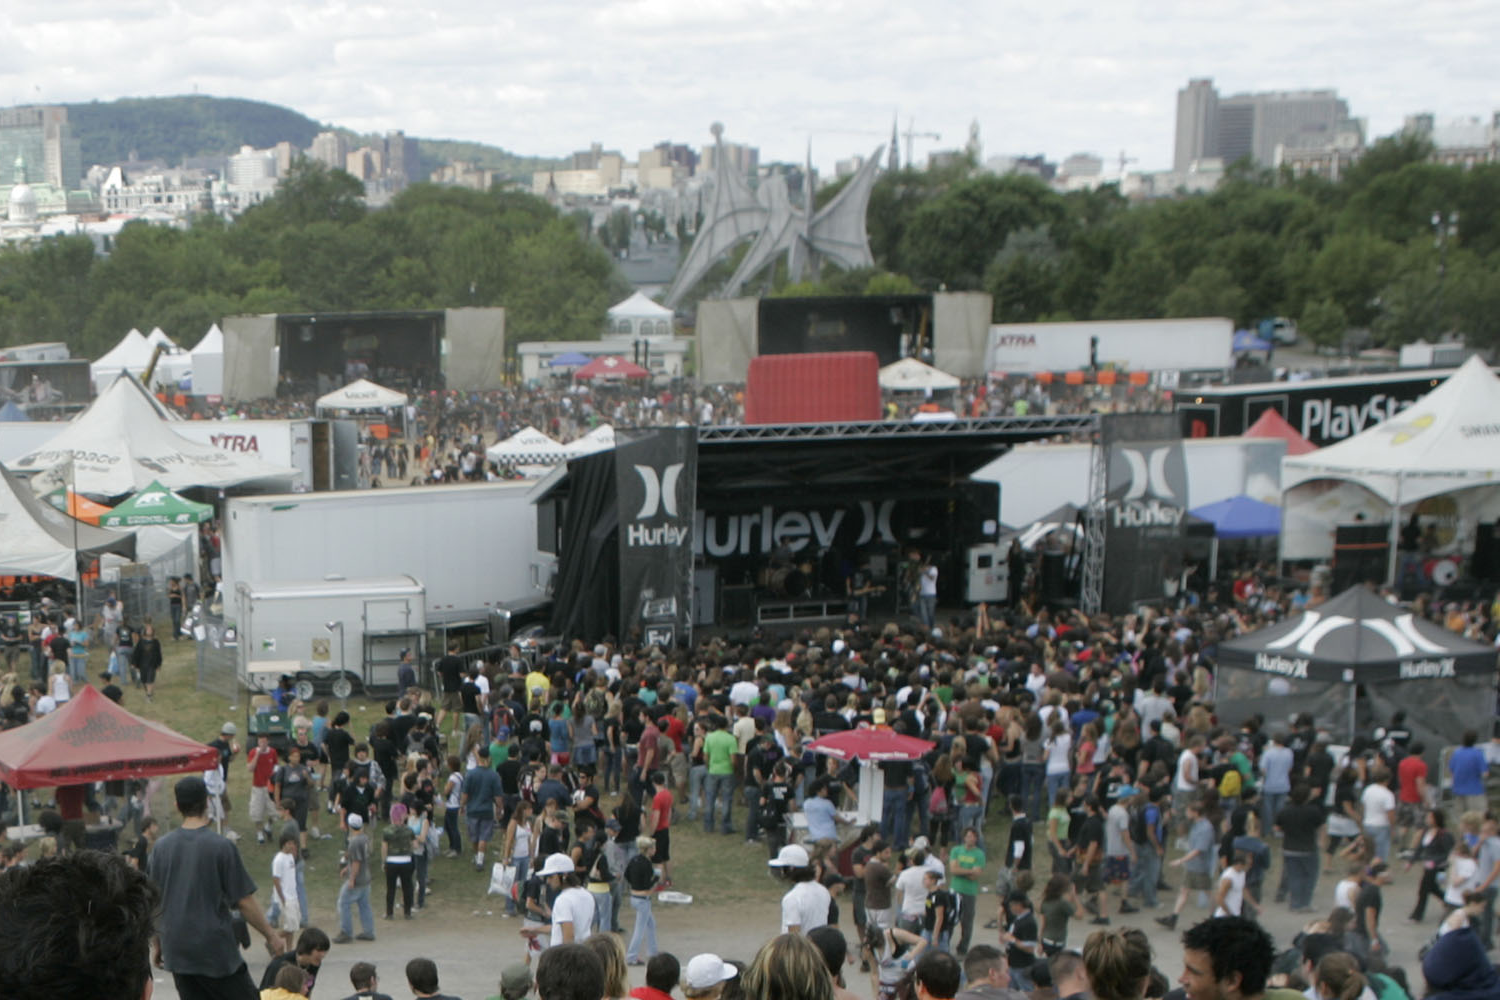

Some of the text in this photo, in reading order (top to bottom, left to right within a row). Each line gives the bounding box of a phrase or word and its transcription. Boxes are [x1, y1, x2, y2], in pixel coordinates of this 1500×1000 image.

[1302, 393, 1426, 440] PlaySt
[1114, 501, 1185, 528] Hurley
[628, 523, 688, 546] Hurley
[1255, 653, 1295, 676] Hurley
[1401, 660, 1442, 678] Hurley
